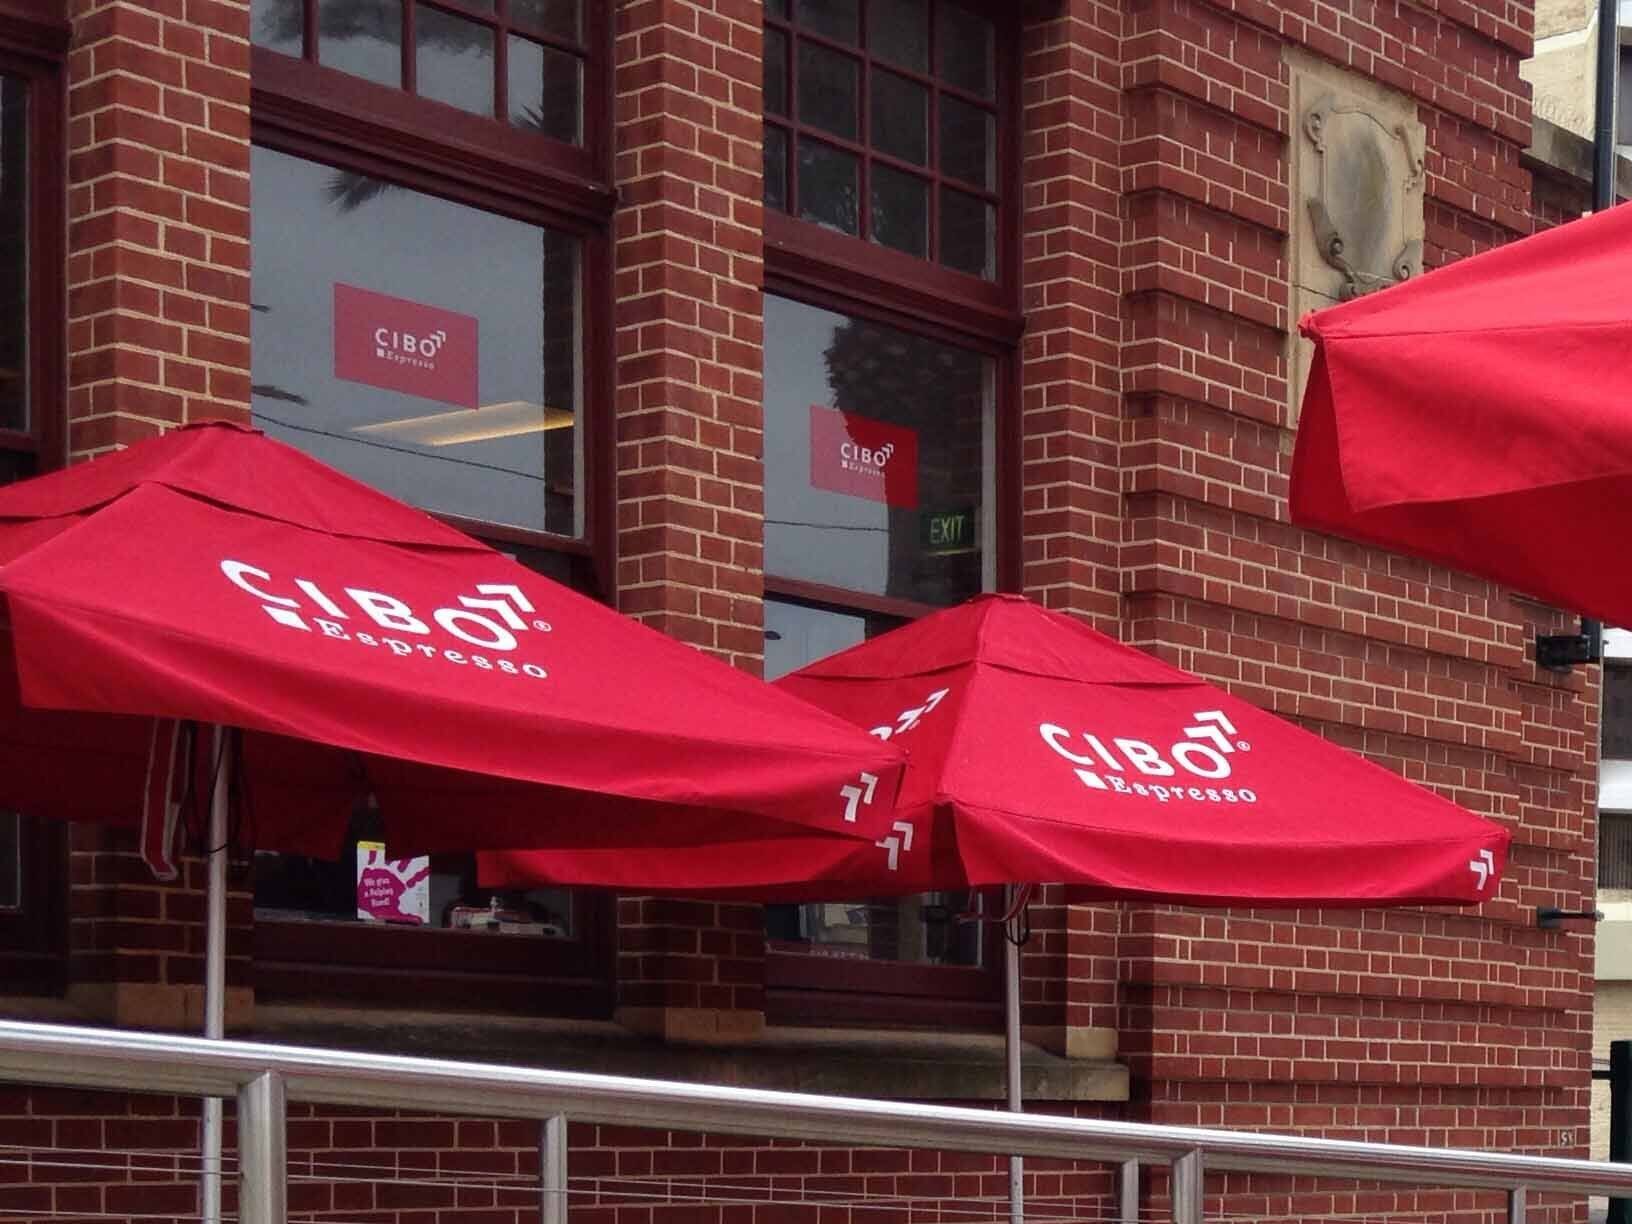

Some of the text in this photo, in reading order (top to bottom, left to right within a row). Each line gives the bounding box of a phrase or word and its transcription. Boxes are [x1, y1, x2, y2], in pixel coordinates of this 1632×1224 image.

[375, 328, 437, 358] CIBO
[840, 442, 887, 467] CIBO
[930, 515, 965, 545] EXIT
[220, 559, 518, 651] CIBO
[314, 617, 548, 679] Espresso
[1039, 723, 1232, 779] CIBO
[1106, 773, 1257, 803] Espresso
